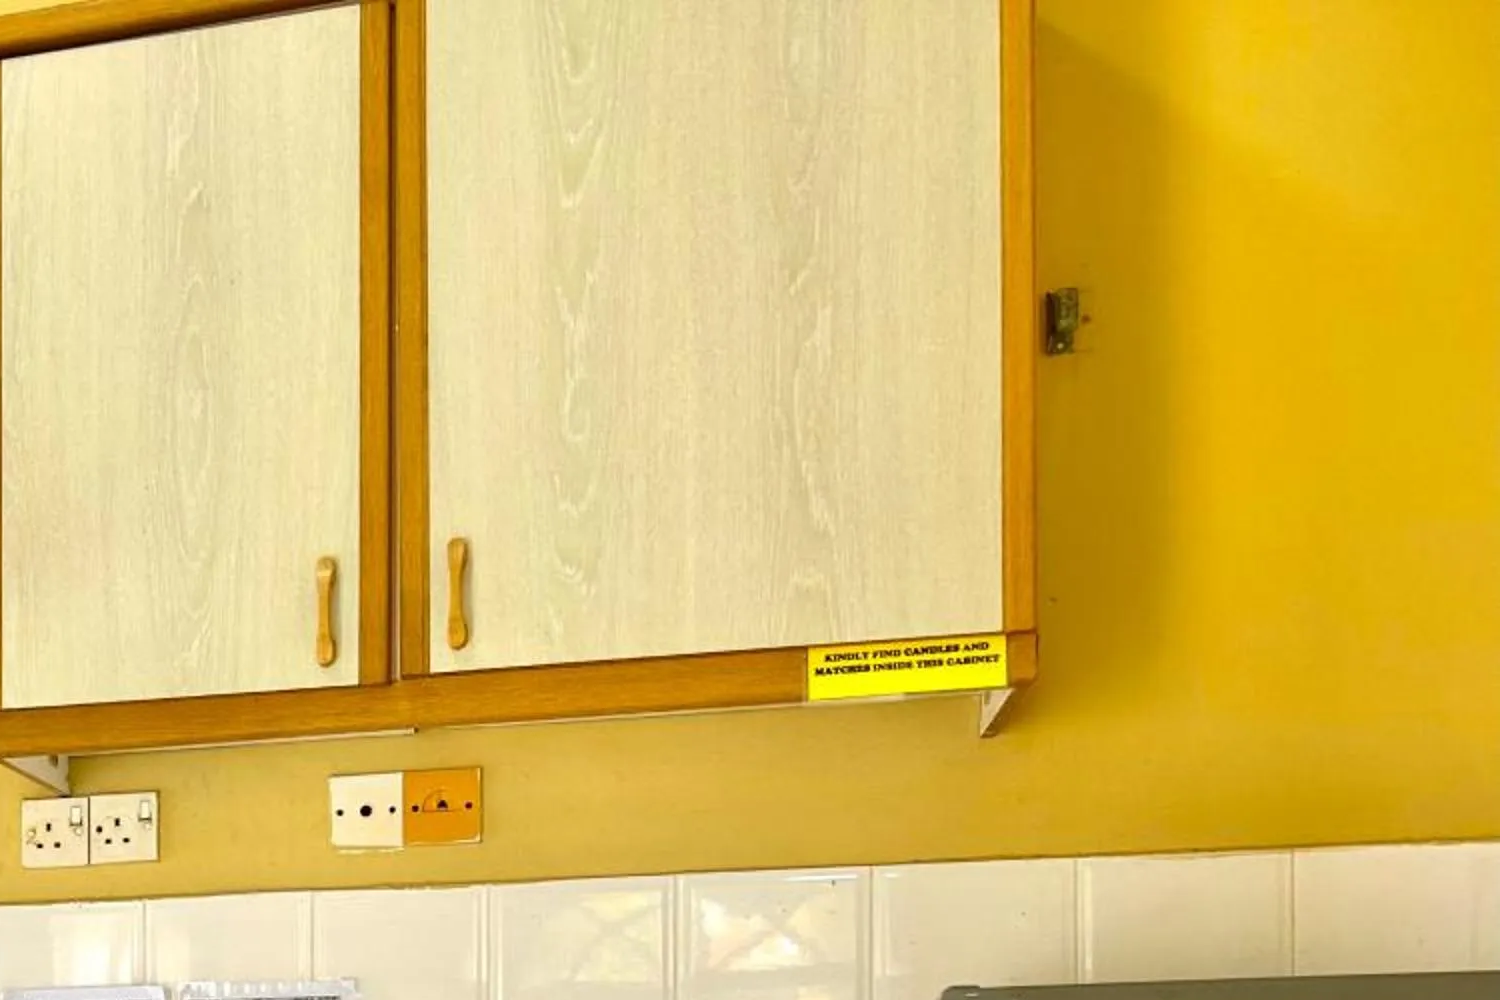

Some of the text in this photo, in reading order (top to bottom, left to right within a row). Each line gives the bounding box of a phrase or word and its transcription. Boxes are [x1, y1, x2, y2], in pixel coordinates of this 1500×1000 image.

[824, 641, 989, 663] KINDLY FIND CANDLES AND
[814, 654, 1000, 676] MATCHES INSIDE THIS CABINET
